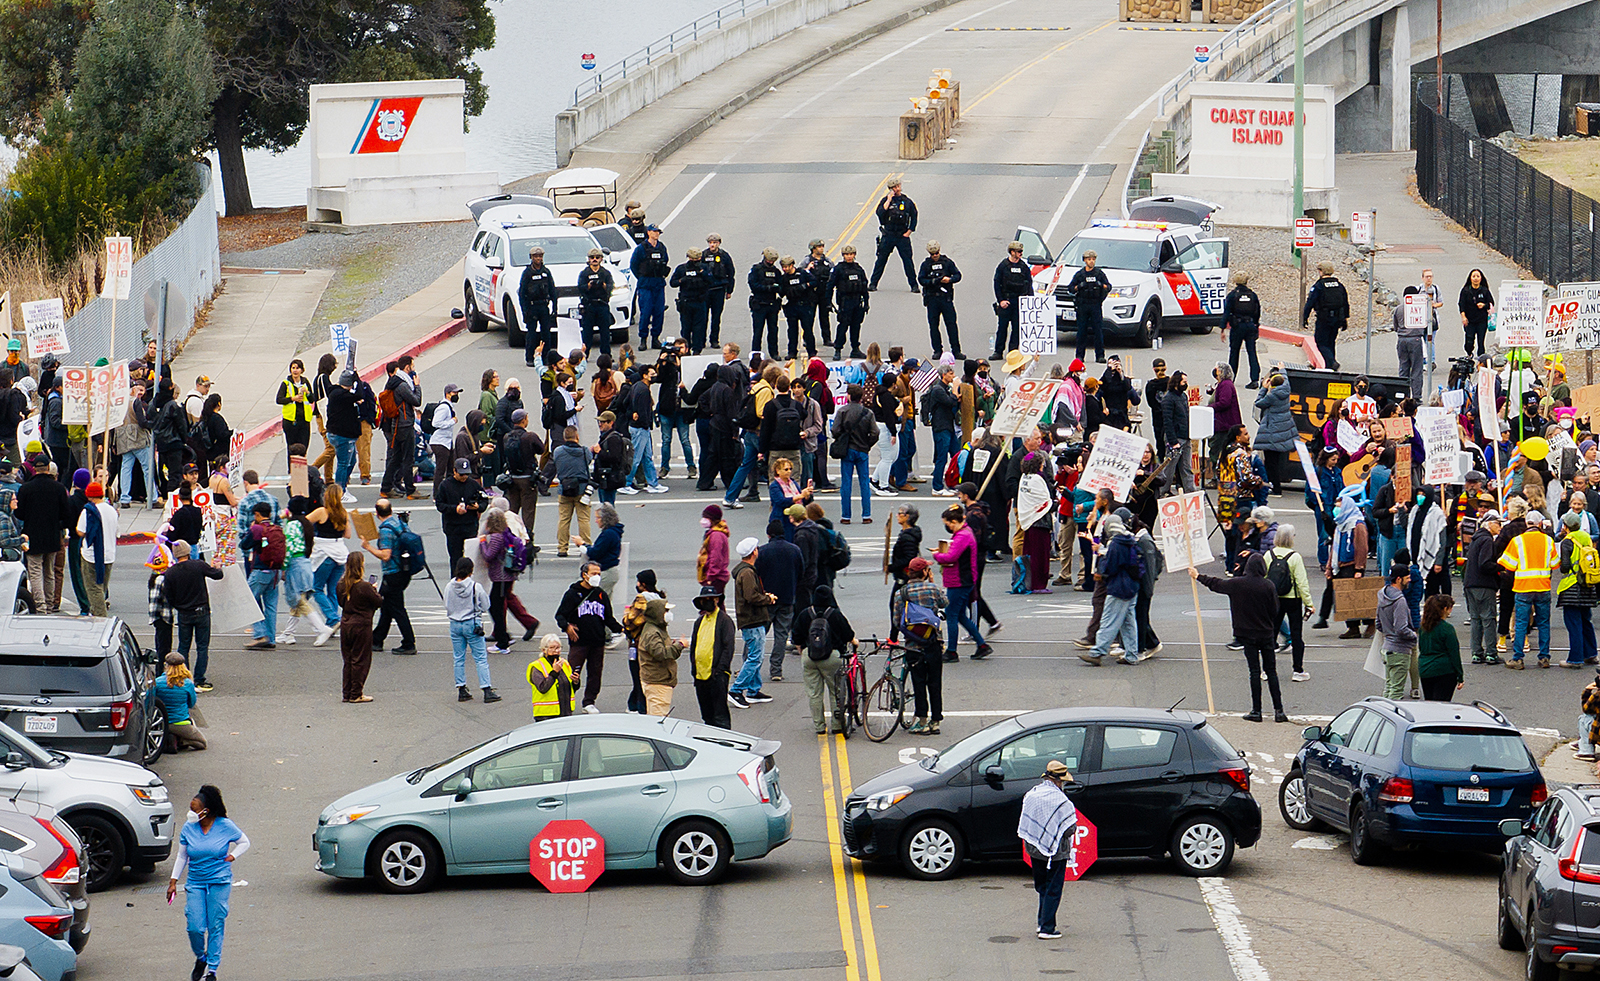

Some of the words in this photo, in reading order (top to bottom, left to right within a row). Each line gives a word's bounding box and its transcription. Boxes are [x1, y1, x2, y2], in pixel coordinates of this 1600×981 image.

[1210, 108, 1255, 124] COAST
[1259, 110, 1306, 126] GUAR
[1232, 128, 1283, 146] ISLAND
[1356, 222, 1366, 230] ANY
[1020, 297, 1050, 310] FUCK
[1200, 299, 1226, 310] FO
[1550, 302, 1579, 316] NO
[1021, 310, 1043, 324] ICE
[1410, 306, 1422, 315] ANY
[1410, 316, 1422, 325] TIME
[1020, 325, 1054, 339] NAZI
[1546, 326, 1574, 338] BAY!
[1022, 340, 1053, 353] SCUM
[1351, 402, 1375, 414] NO
[1384, 419, 1410, 428] ICE
[232, 432, 244, 448] NO
[539, 838, 597, 859] STOP
[550, 860, 586, 880] ICE
